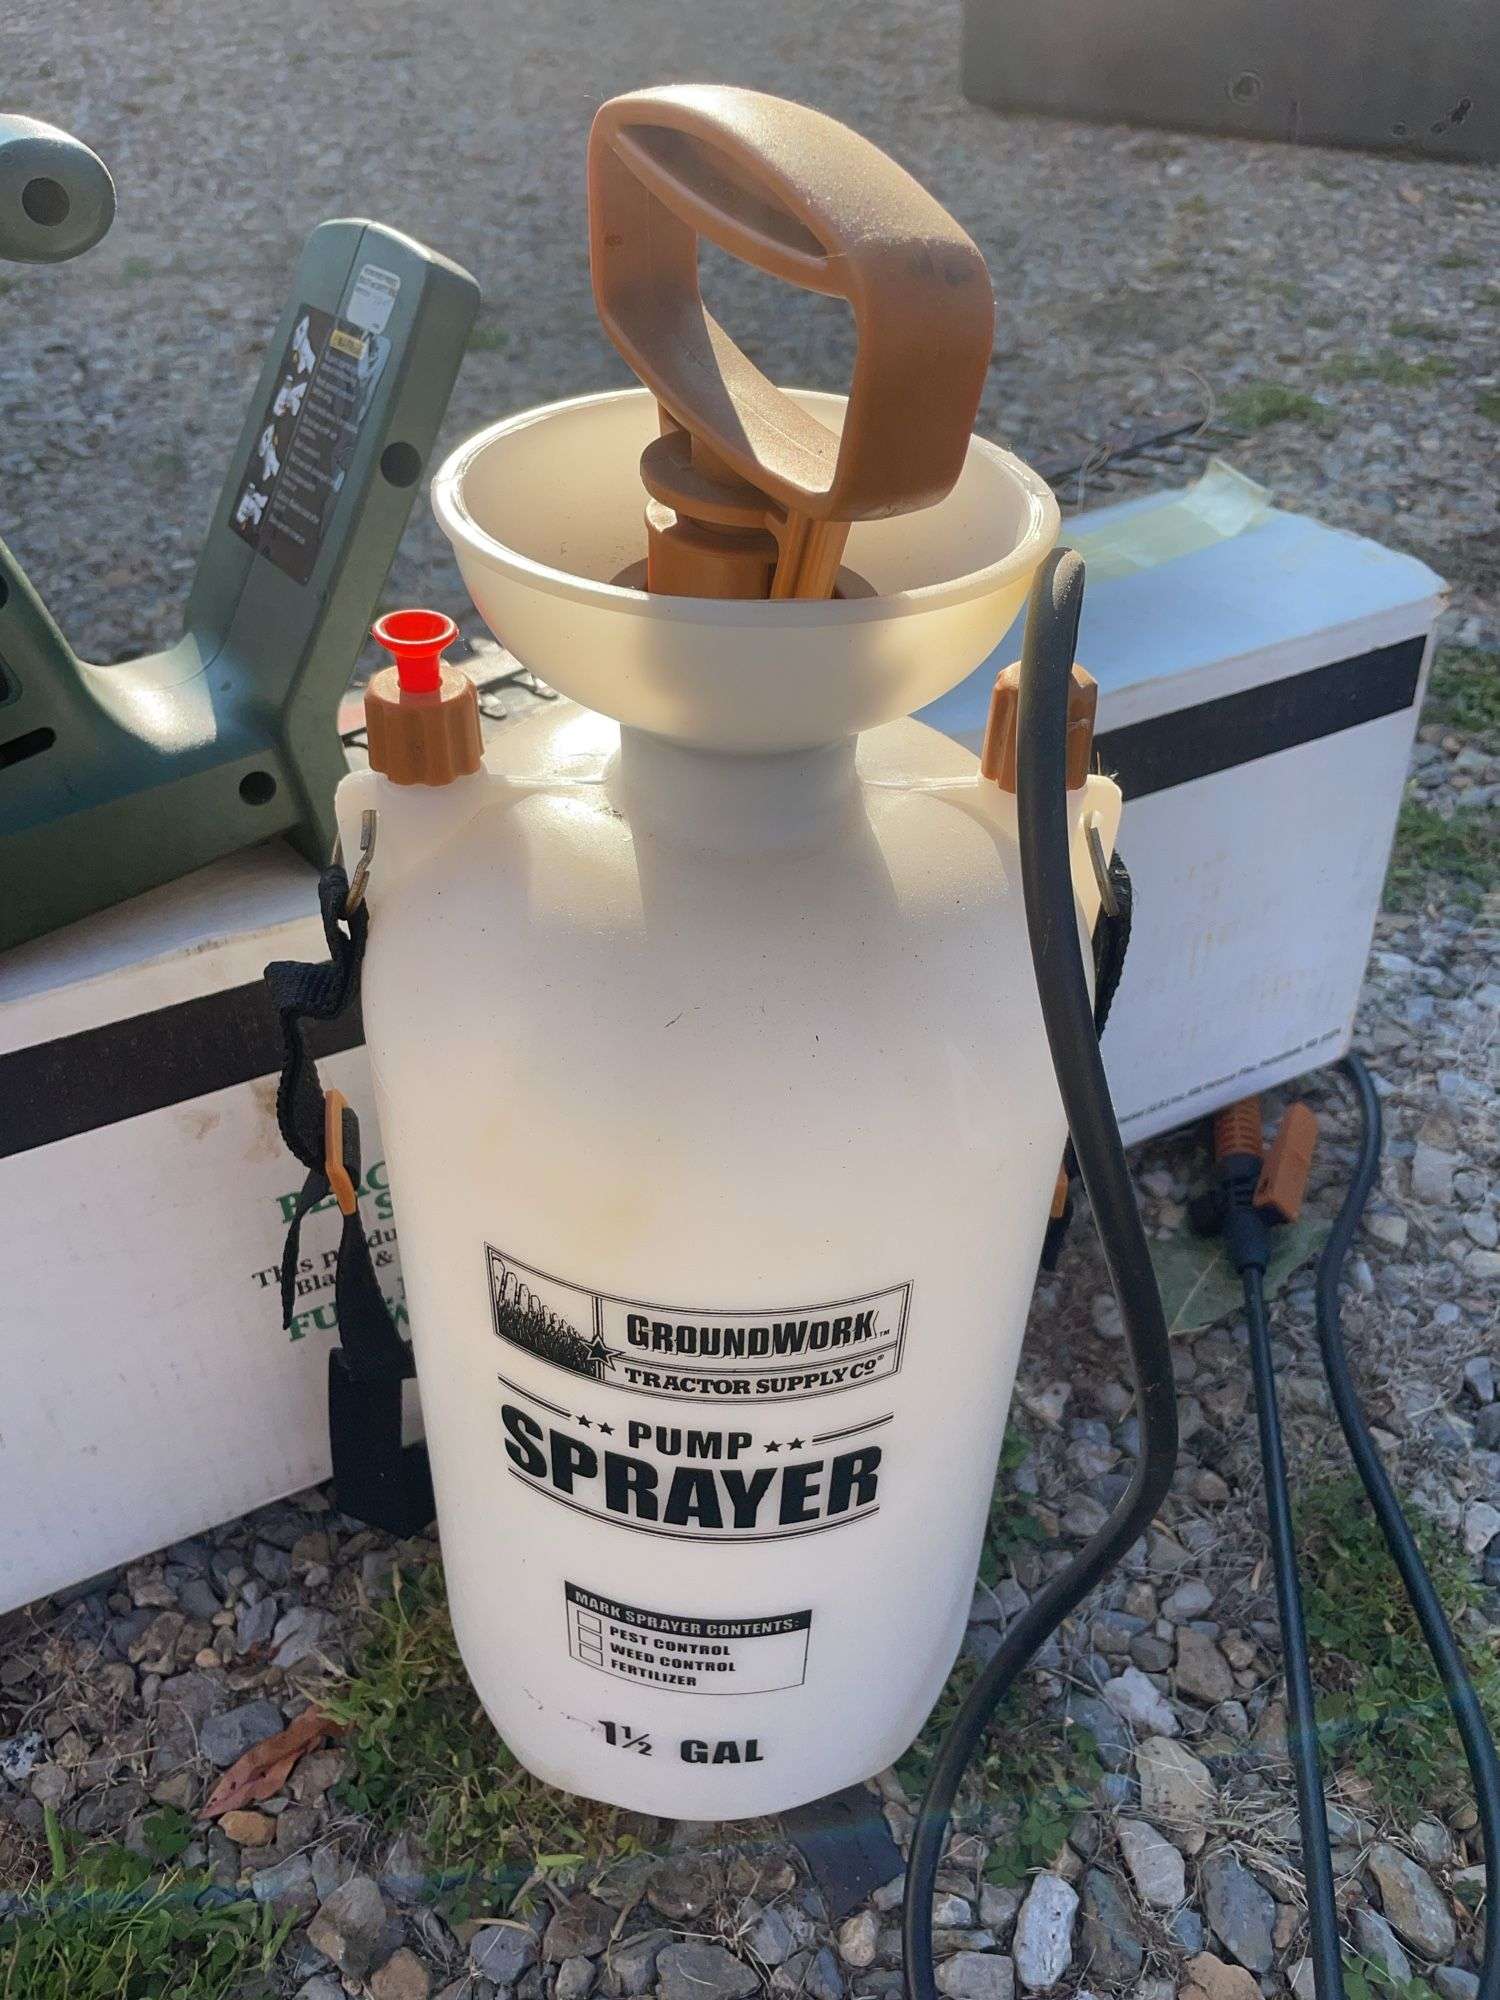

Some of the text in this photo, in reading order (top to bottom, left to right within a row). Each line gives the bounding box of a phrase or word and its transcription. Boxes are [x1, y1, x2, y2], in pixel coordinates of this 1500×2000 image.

[375, 1250, 393, 1268] &
[624, 1367, 752, 1396] TRACTOR
[755, 1366, 849, 1395] SUPPLY
[628, 1420, 753, 1460] PUMP
[501, 1404, 882, 1529] SPRAYER
[575, 1591, 800, 1637] MARK SPRAYER CONTENTS:
[609, 1625, 731, 1656] PEST CONTROL
[610, 1642, 737, 1672] WEED CONTROL
[611, 1659, 697, 1687] FERTILIZER
[679, 1738, 764, 1764] GAL
